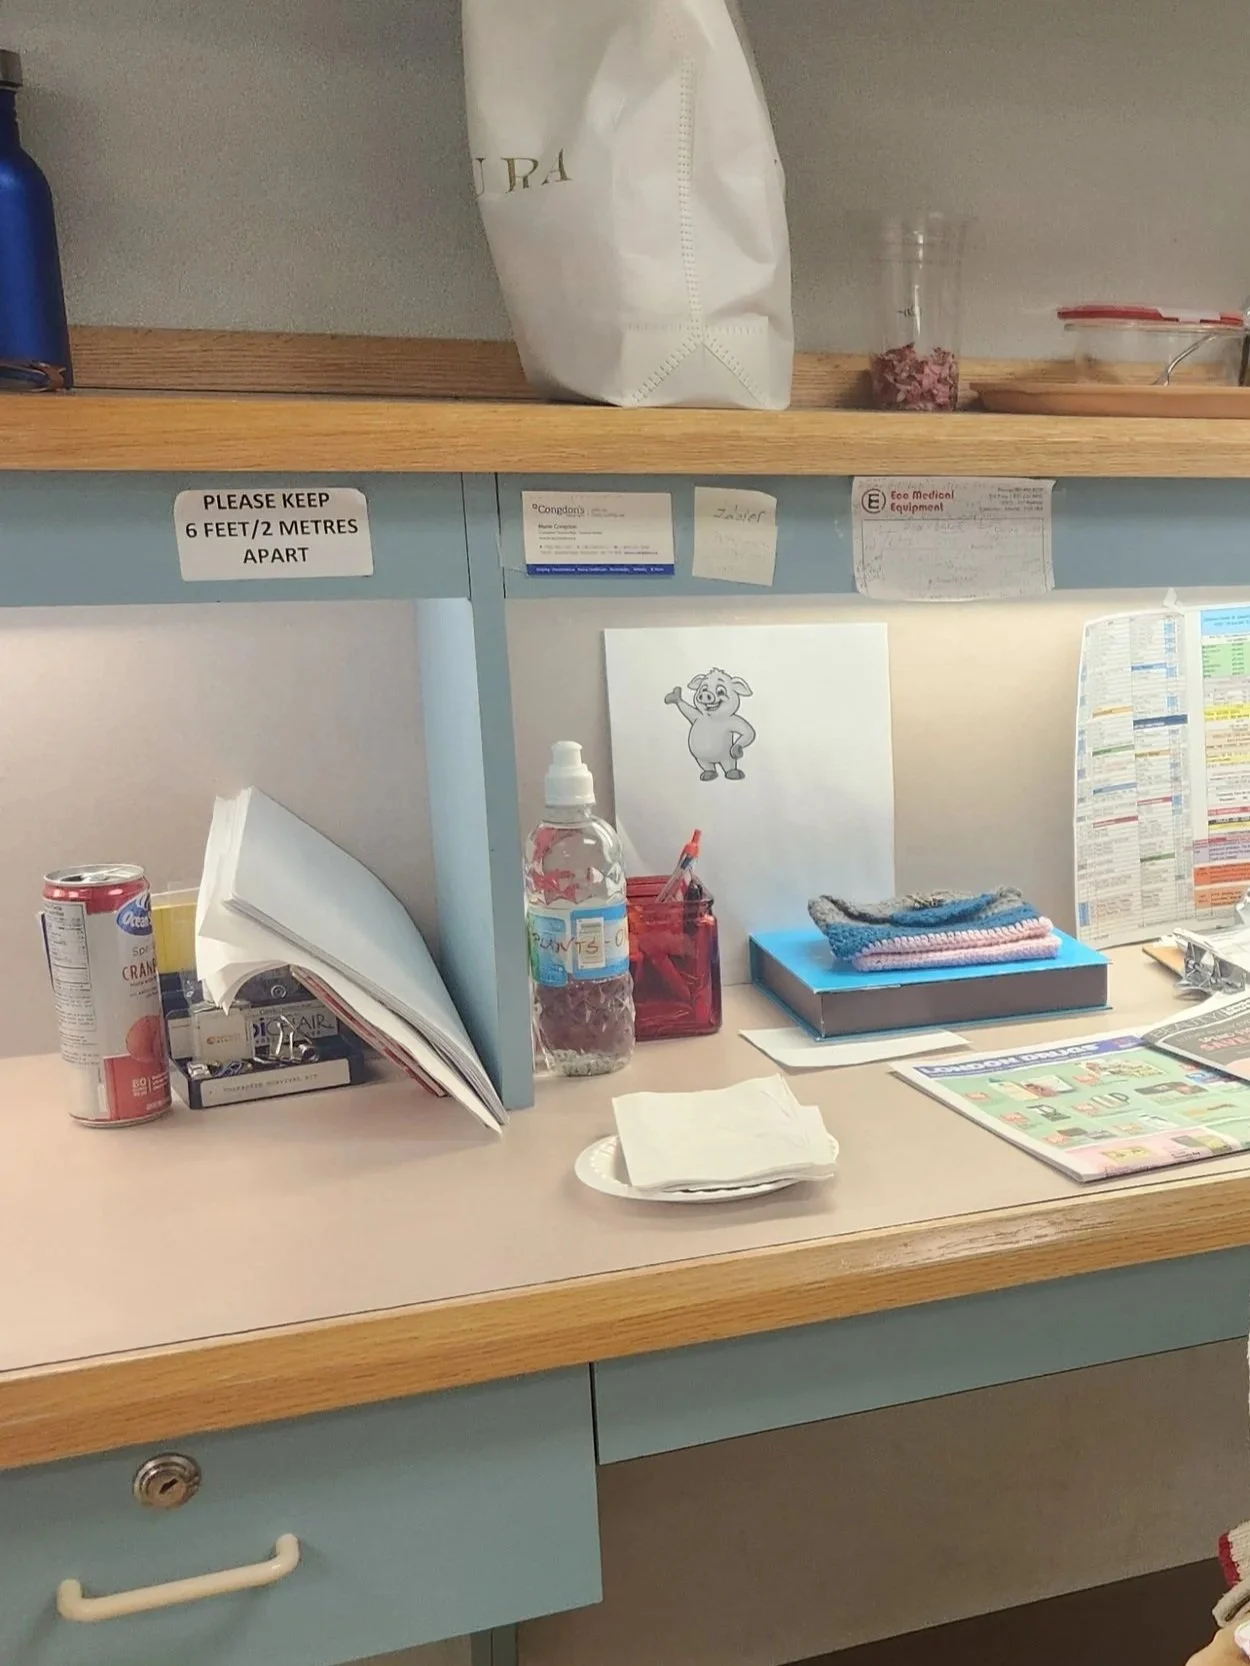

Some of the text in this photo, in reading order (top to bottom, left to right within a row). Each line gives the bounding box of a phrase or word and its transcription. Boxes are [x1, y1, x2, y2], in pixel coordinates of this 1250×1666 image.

[203, 492, 330, 510] PLEASE KEEP
[912, 489, 955, 501] Medical
[890, 502, 944, 515] Equipment
[185, 518, 358, 540] 6 FEET/2 METRES
[243, 547, 309, 564] APART
[1200, 1034, 1249, 1051] SAVE
